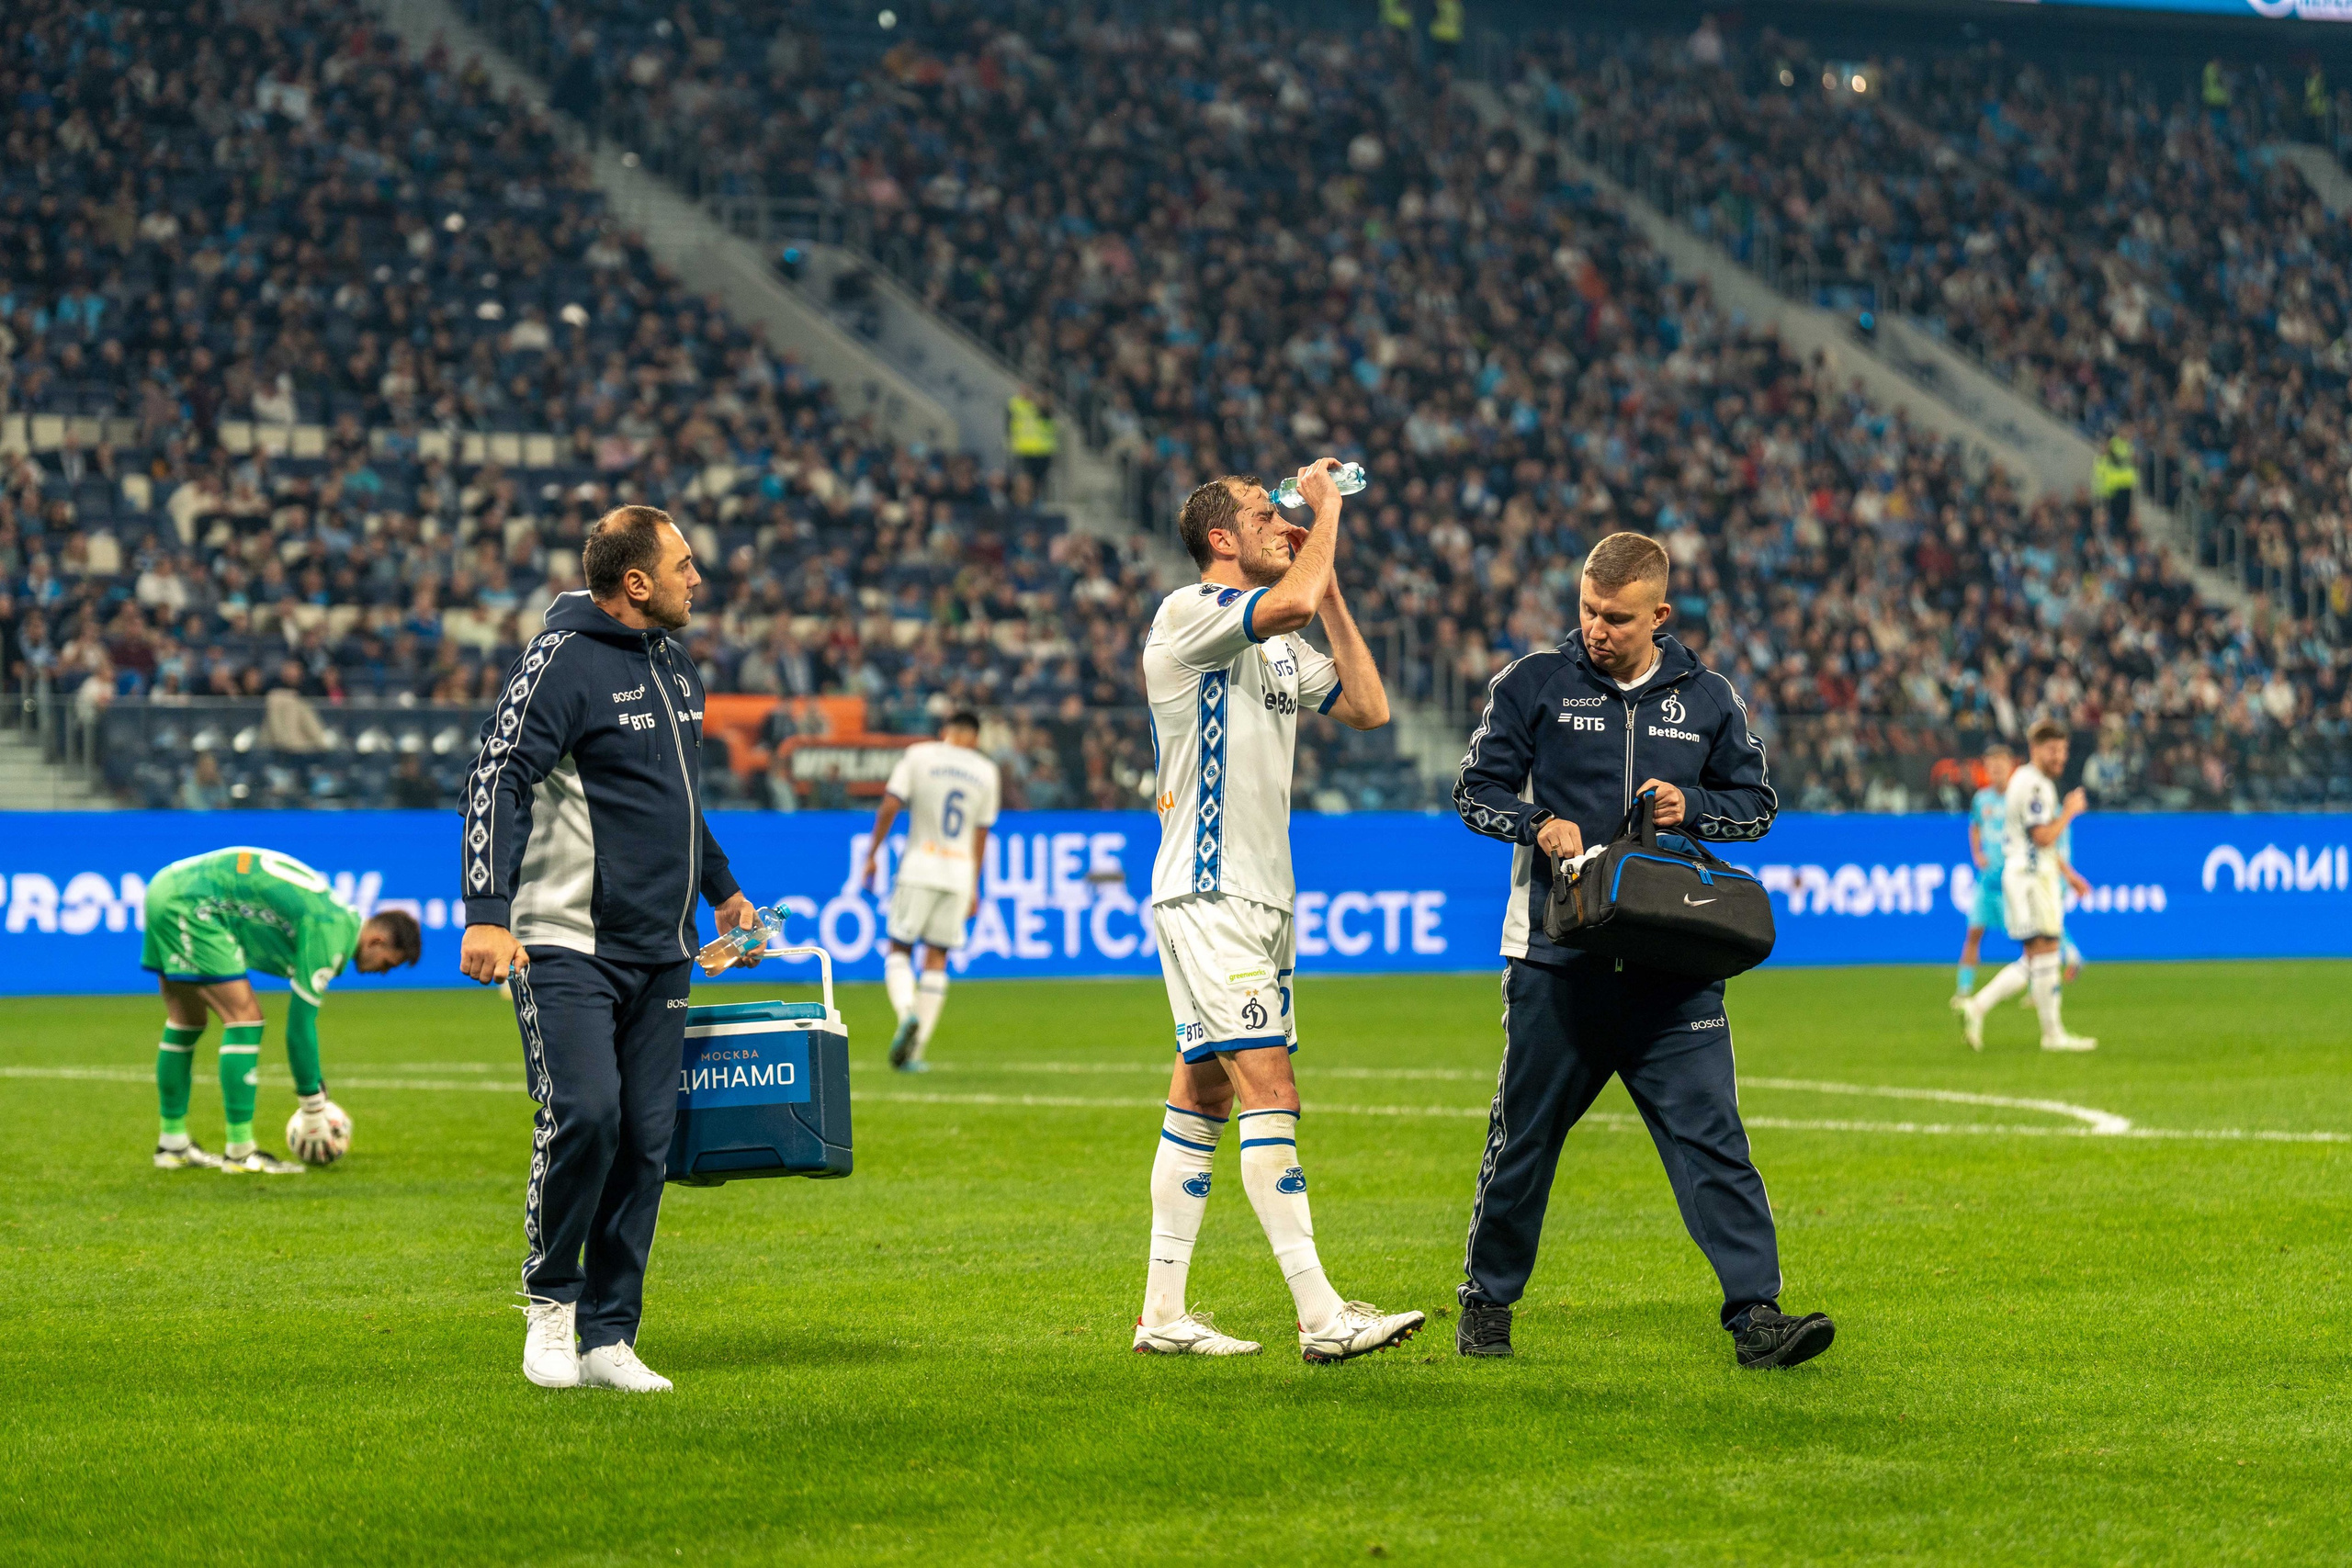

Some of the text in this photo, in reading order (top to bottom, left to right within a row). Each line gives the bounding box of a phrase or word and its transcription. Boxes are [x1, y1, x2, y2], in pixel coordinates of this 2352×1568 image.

[613, 689, 643, 704] BOSCO
[1563, 697, 1601, 707] BOSCO
[630, 713, 655, 731] ВТБ
[1574, 716, 1606, 731] ВТБ
[1649, 726, 1700, 743] BetBoom
[942, 789, 965, 838] 6
[1295, 891, 1448, 956] ЕСТЕ
[1229, 969, 1266, 982] greenworks
[1187, 1022, 1204, 1042] ВТБ
[1690, 1020, 1724, 1030] BOSCO
[701, 1049, 759, 1062] МОСКВА
[678, 1063, 795, 1094] ДИНАМО
